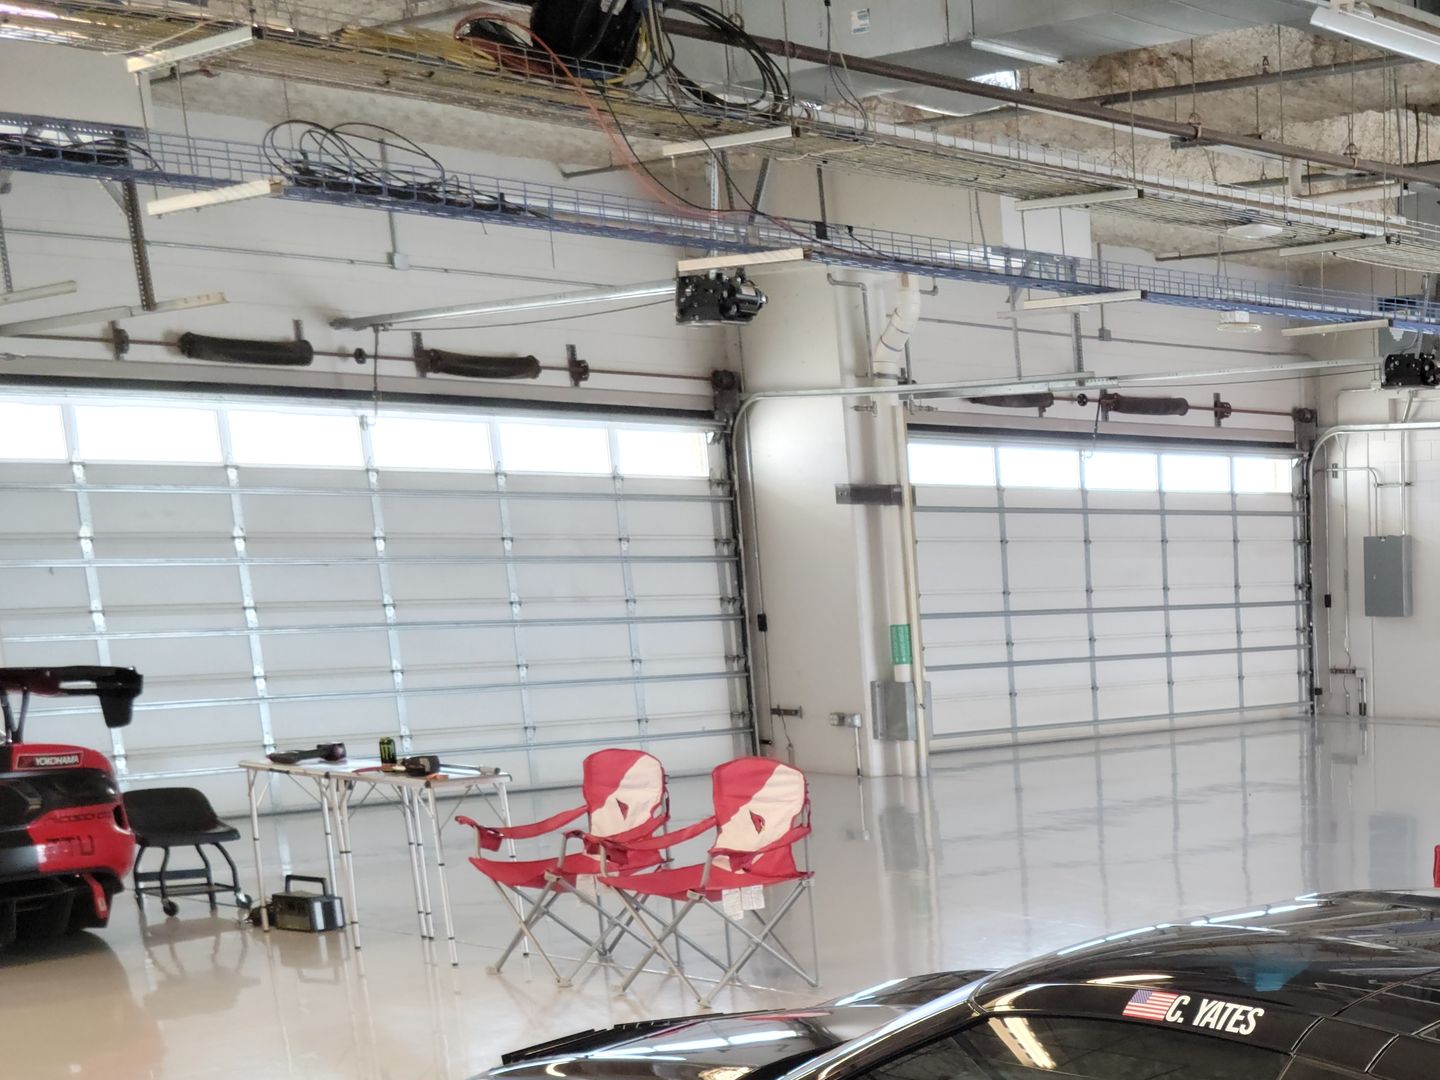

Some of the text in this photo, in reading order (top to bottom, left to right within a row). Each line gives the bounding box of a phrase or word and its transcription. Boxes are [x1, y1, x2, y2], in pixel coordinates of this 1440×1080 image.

[35, 755, 79, 766] YOKOHAMA
[1165, 994, 1265, 1036] C. YATES
